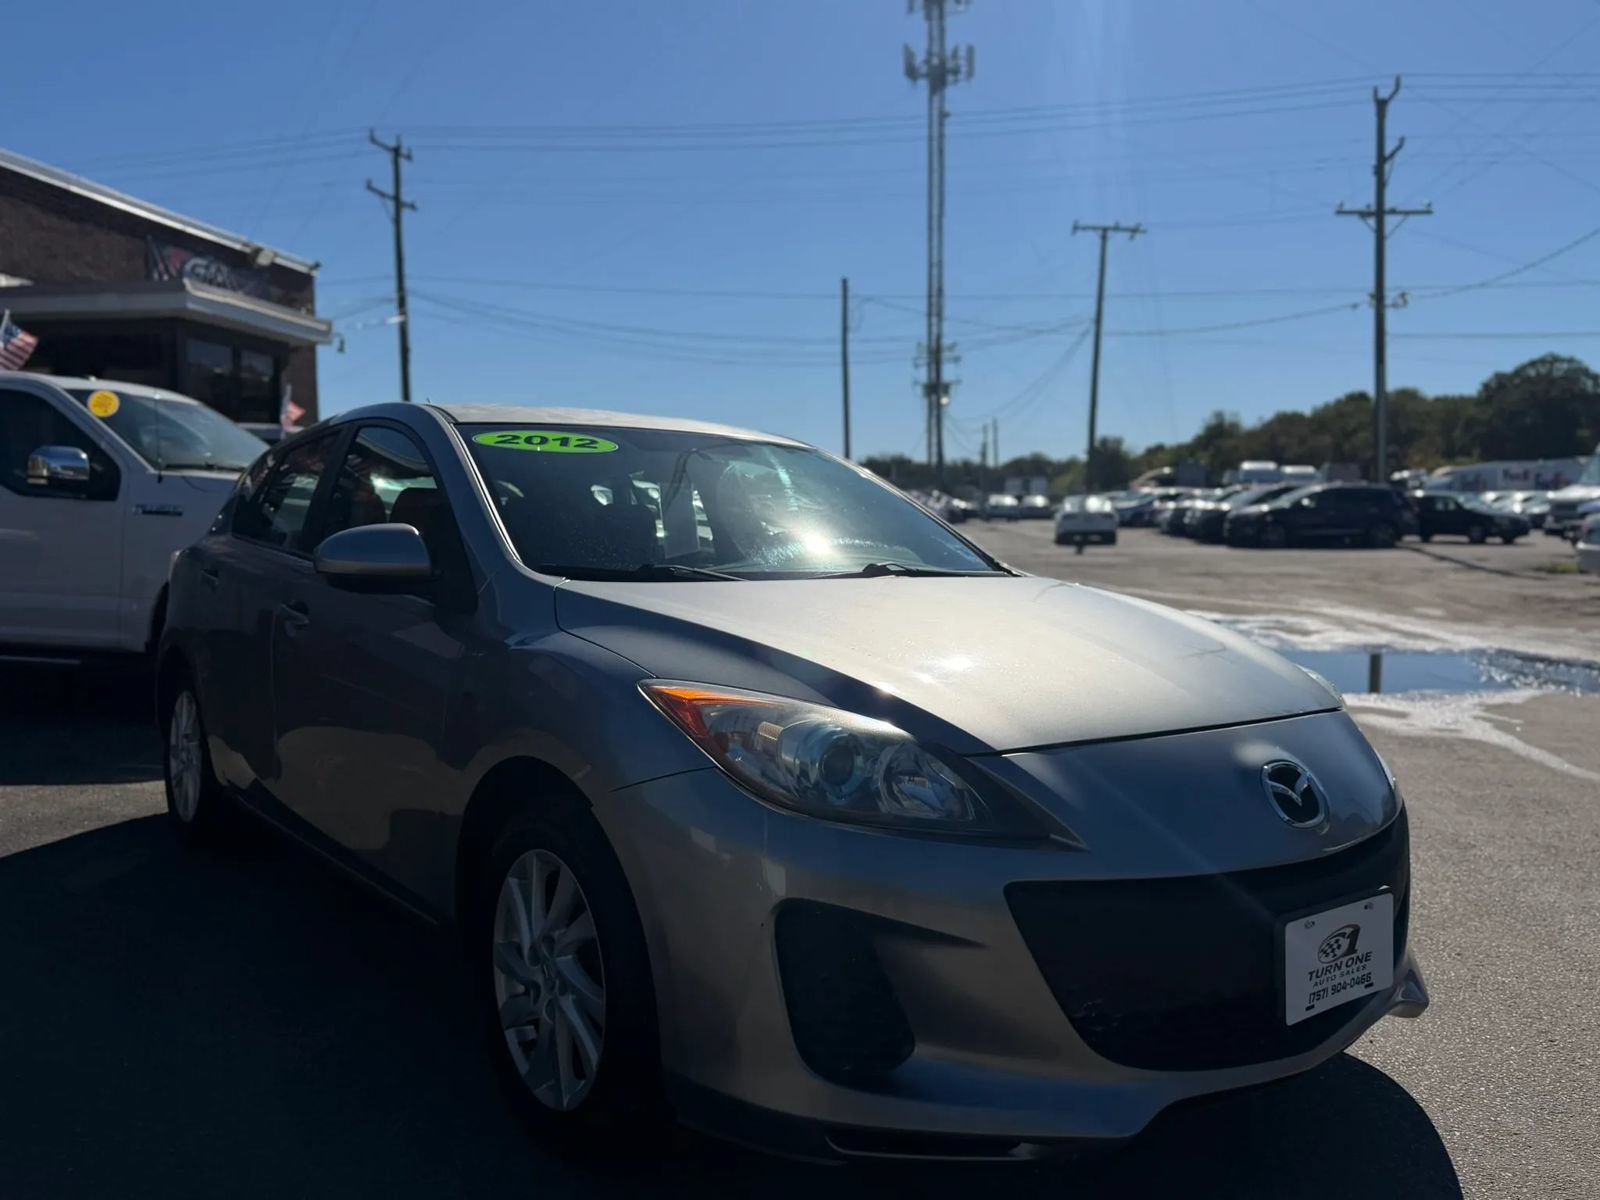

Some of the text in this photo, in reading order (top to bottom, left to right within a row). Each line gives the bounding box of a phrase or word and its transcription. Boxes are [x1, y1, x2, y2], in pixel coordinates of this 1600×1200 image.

[494, 434, 599, 449] 2012
[1308, 951, 1373, 981] TURN ONE
[1313, 964, 1367, 988] AUTO SALES
